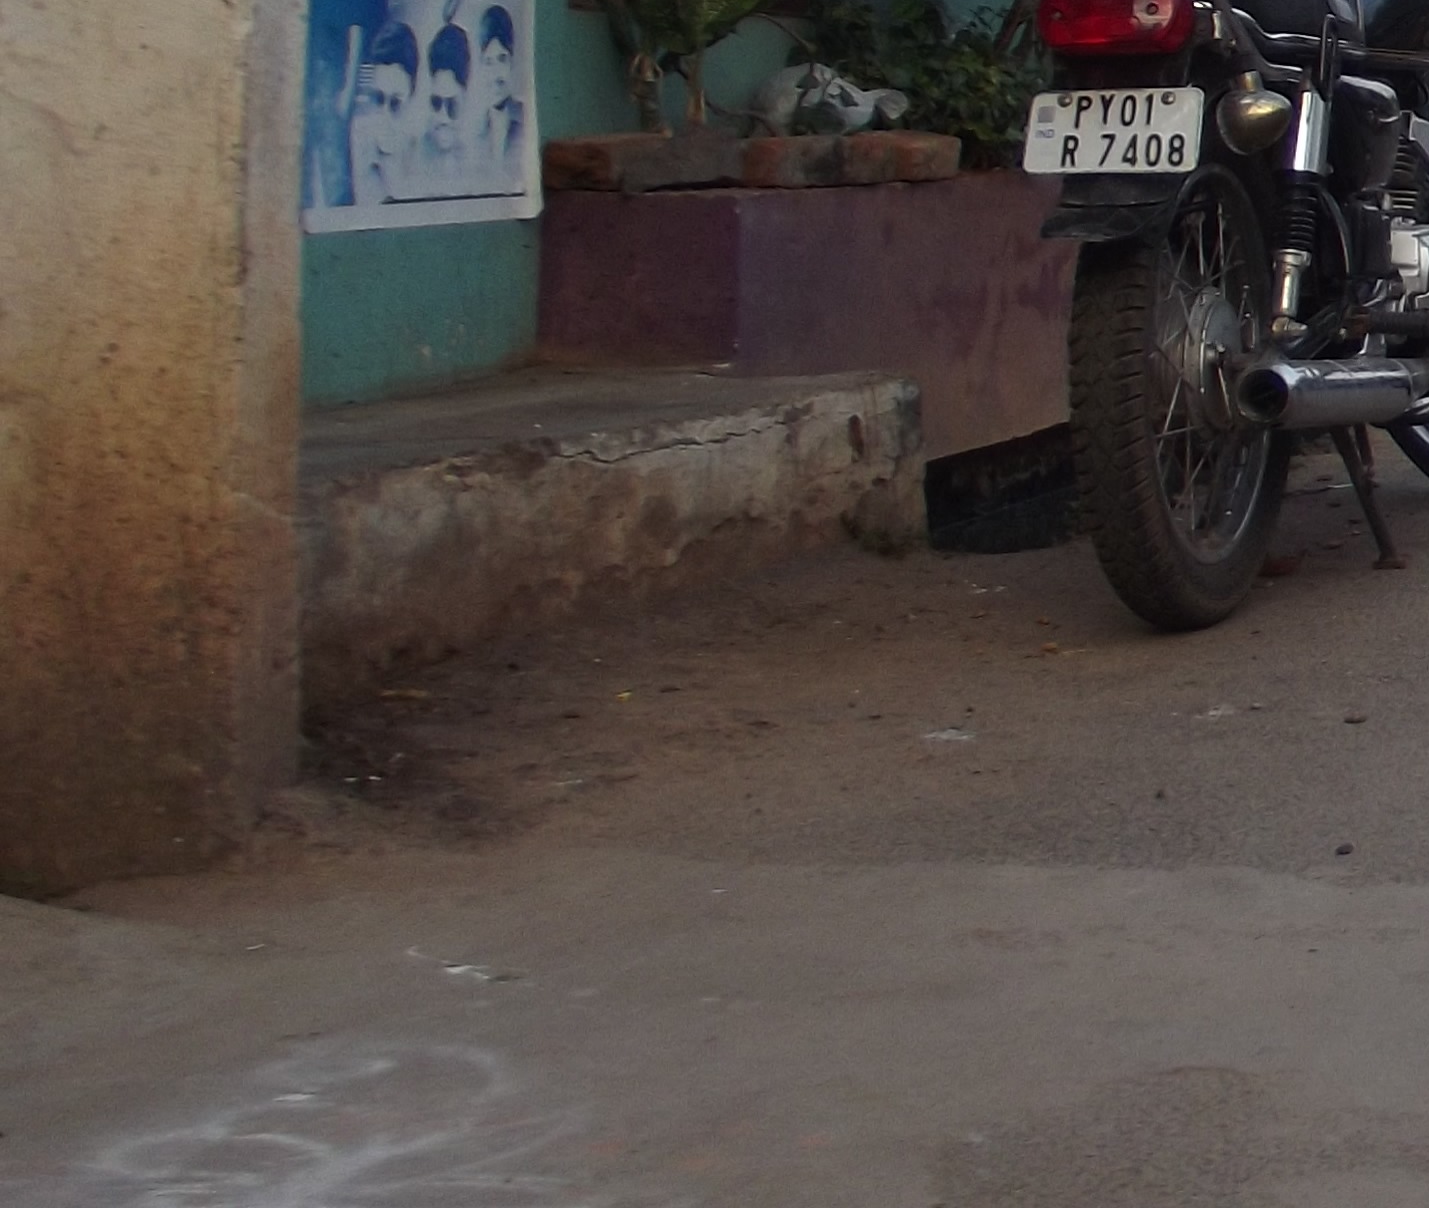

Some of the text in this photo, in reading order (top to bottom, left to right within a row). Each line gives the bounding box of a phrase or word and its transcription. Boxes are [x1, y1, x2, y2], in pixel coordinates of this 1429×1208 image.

[1074, 94, 1155, 129] PY01
[1060, 133, 1186, 168] R 7408
